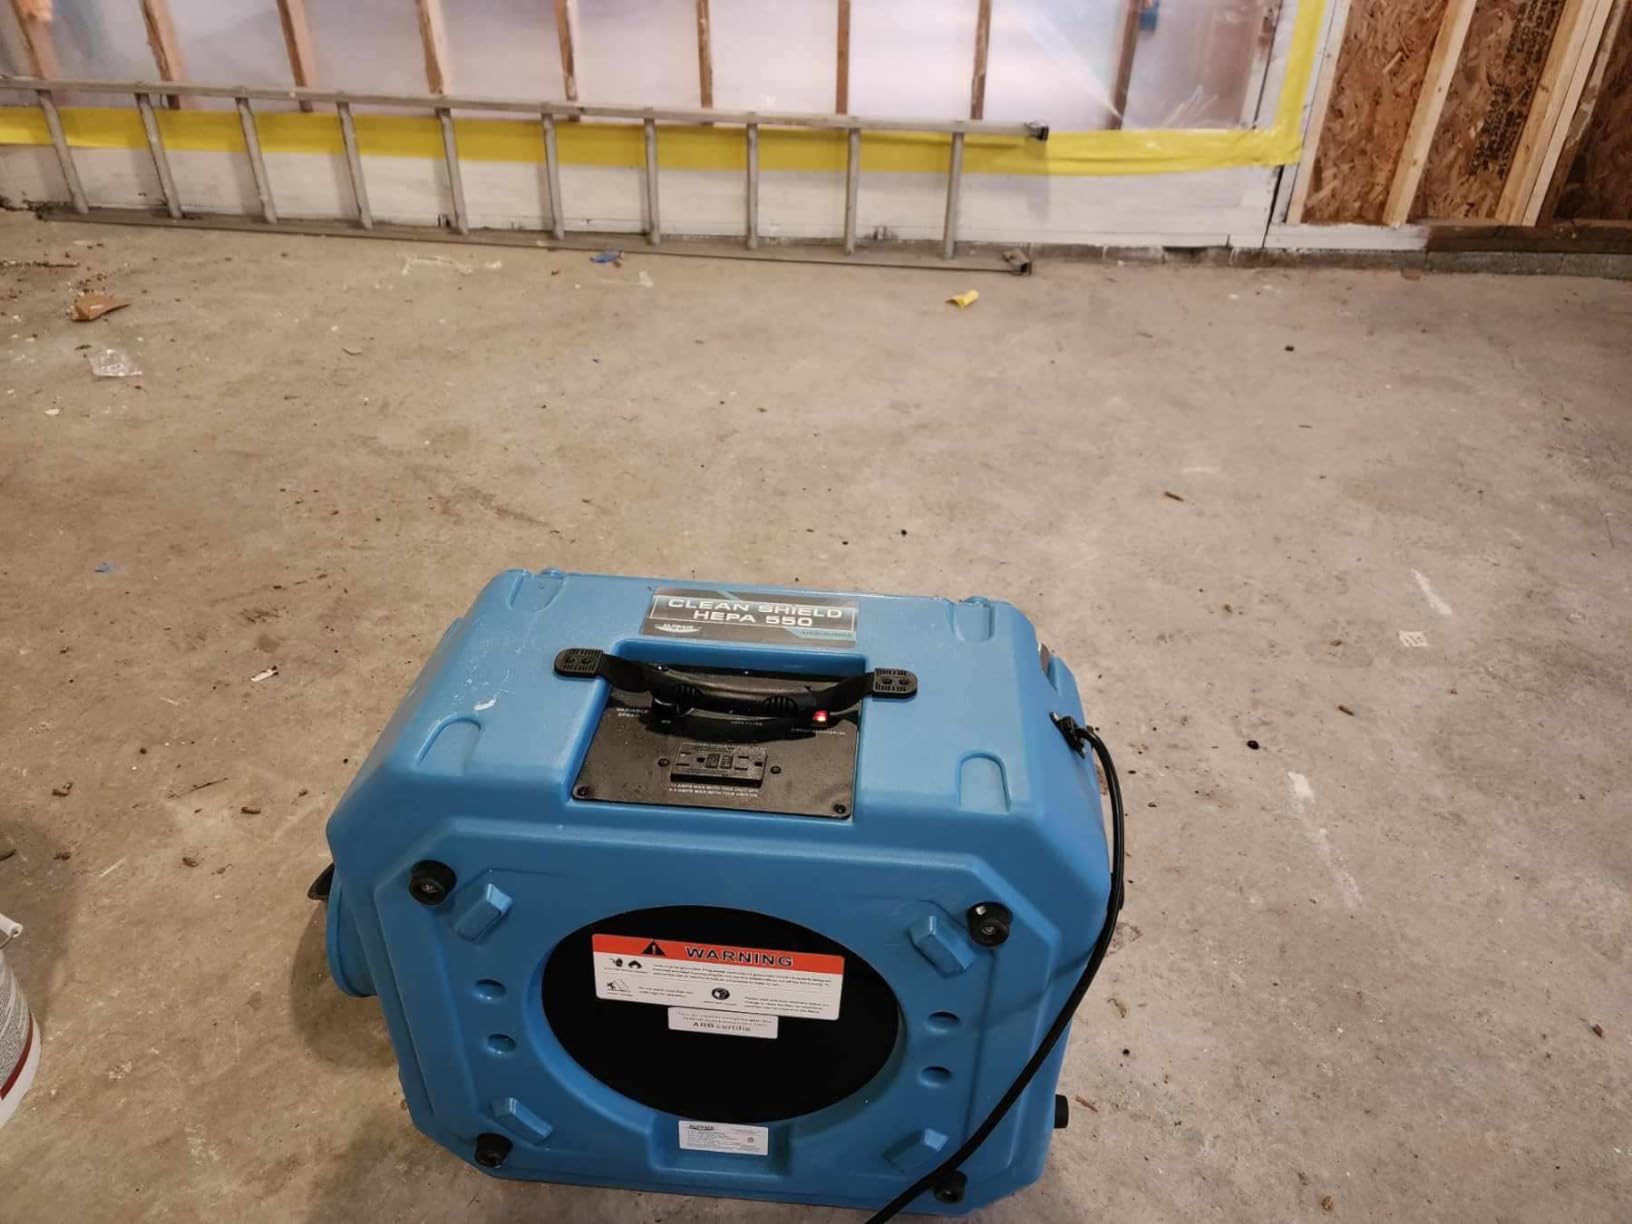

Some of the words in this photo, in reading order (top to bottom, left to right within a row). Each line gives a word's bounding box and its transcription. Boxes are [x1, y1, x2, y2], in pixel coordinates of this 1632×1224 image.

[668, 598, 749, 612] CLEAN
[758, 604, 842, 619] SHIELD
[693, 610, 757, 623] HEPA
[765, 615, 813, 627] 550
[685, 946, 793, 967] WARNING
